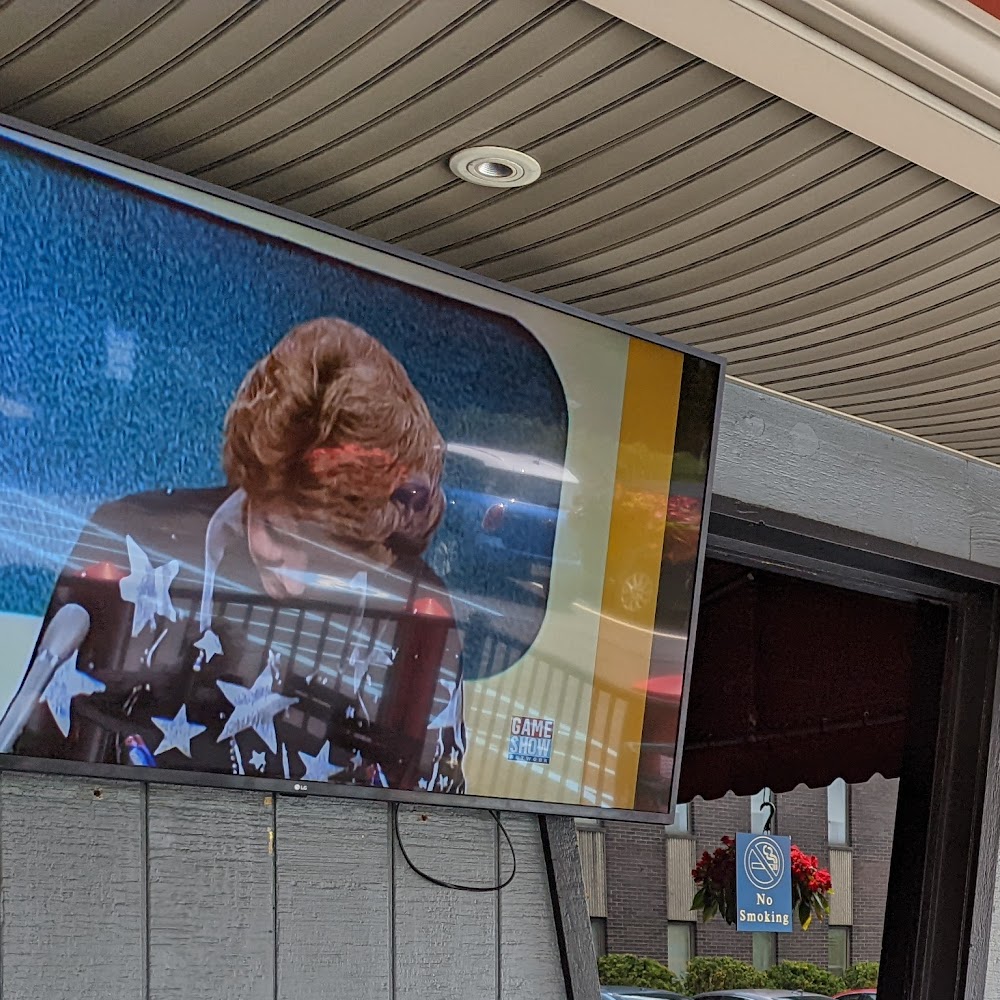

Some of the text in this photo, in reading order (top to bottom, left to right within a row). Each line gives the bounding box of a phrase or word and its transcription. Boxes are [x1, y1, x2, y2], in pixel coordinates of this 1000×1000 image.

[511, 717, 553, 738] GAME
[510, 736, 551, 757] SHOW
[757, 893, 773, 906] No
[739, 910, 789, 926] Smoking
